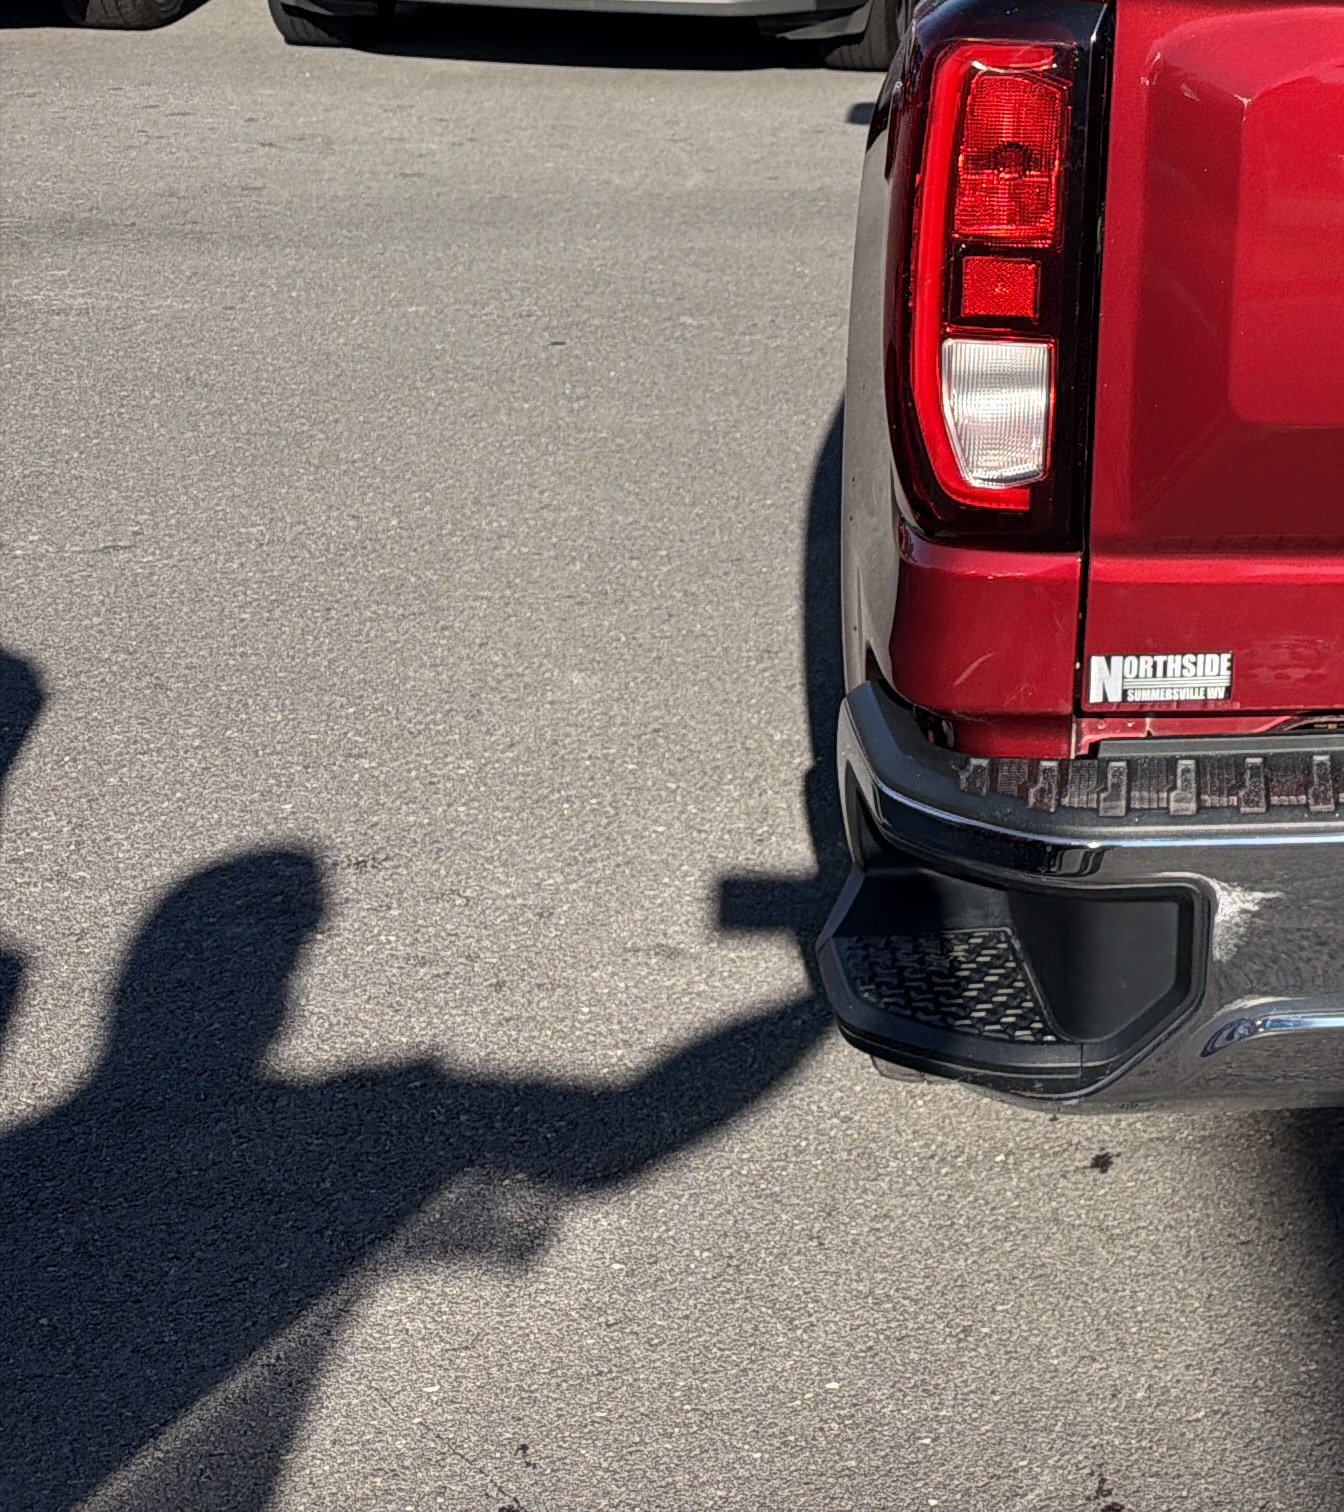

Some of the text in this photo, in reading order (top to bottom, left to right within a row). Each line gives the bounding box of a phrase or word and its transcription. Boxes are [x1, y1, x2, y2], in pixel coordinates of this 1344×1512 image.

[1089, 653, 1232, 703] NORTHSIDE
[1127, 687, 1226, 701] SUMMERSVILLE WV
